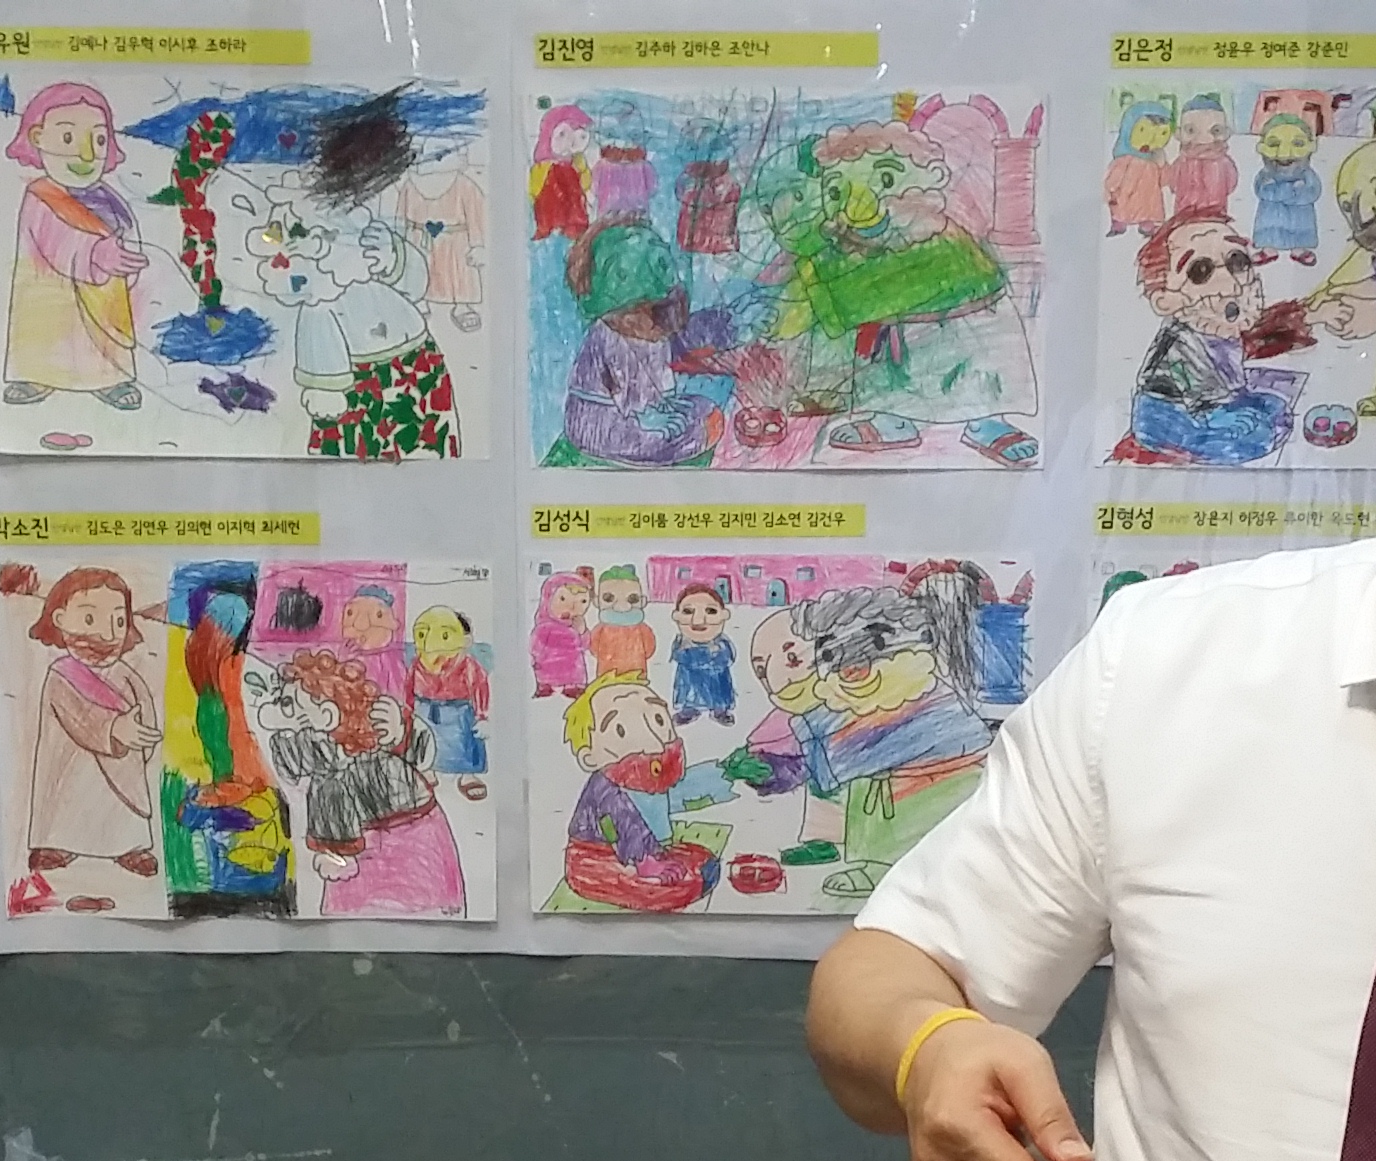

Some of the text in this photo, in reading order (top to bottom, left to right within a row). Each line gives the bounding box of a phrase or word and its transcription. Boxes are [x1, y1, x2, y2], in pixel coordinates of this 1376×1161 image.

[205, 37, 247, 53] 조하라
[539, 38, 594, 62] 김진영
[635, 40, 676, 58] 김주하
[728, 40, 770, 57] 조안나
[1114, 38, 1173, 62] 김은정
[131, 520, 170, 537] 김연우
[534, 509, 591, 532] 김성식
[674, 512, 715, 529] 강선우
[719, 511, 757, 529] 김지민
[762, 511, 802, 529] 김소연
[807, 511, 847, 529] 김건우
[1097, 507, 1155, 531] 김형성
